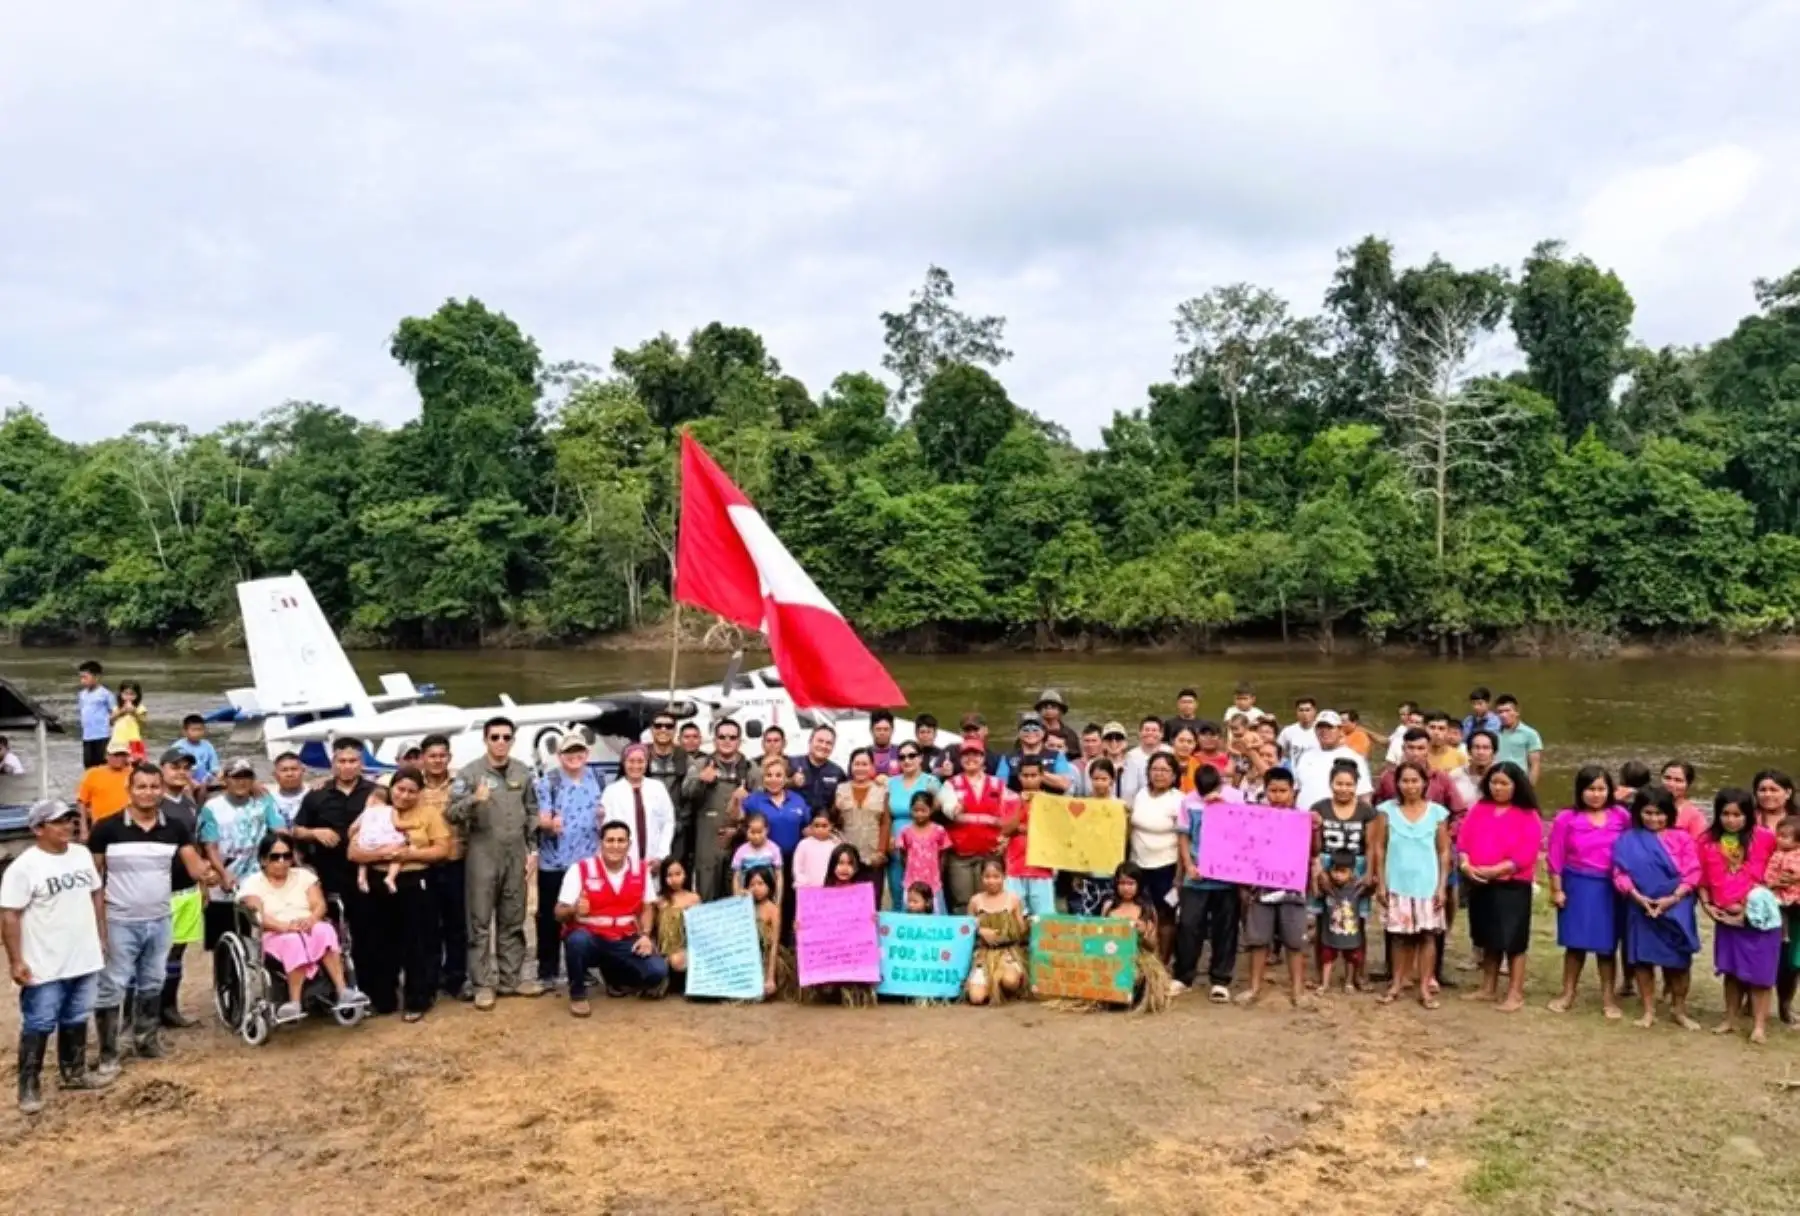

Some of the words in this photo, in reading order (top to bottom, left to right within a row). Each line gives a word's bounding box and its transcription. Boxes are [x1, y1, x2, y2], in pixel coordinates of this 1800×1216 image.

[46, 868, 94, 896] BOSS
[896, 925, 954, 941] GRACIAS
[888, 945, 917, 961] POR
[891, 966, 961, 985] SERVICIO
